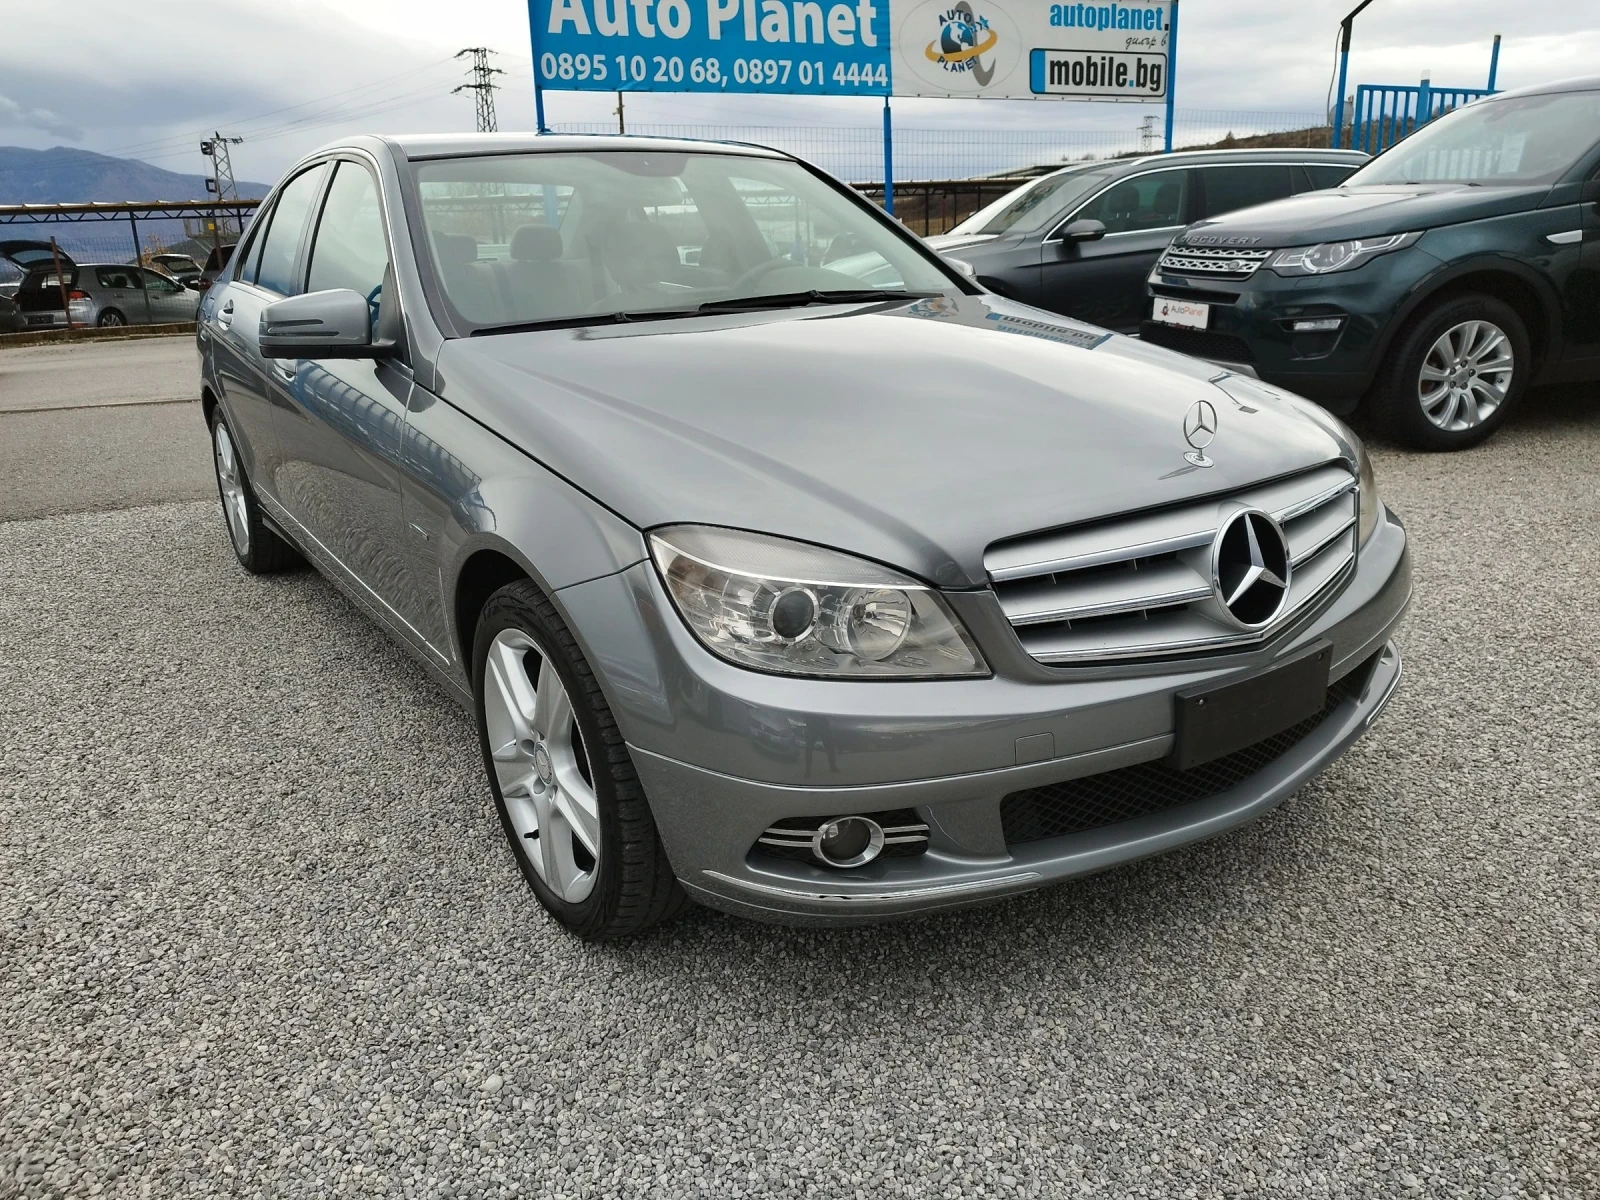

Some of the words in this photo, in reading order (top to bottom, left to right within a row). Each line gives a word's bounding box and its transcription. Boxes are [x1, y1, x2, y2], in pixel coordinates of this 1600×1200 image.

[548, 0, 691, 39] Auto
[707, 0, 877, 47] Planet
[939, 9, 973, 26] AUTO
[540, 52, 607, 81] 0895
[615, 55, 647, 82] 10
[653, 56, 684, 83] 20
[690, 57, 727, 87] 68,
[733, 59, 793, 85] 0897
[799, 61, 824, 86] 01
[832, 62, 888, 87] 4444
[937, 55, 978, 73] PLANET
[1049, 56, 1162, 92] mobile.bg
[1181, 235, 1262, 245] DISCOVERY
